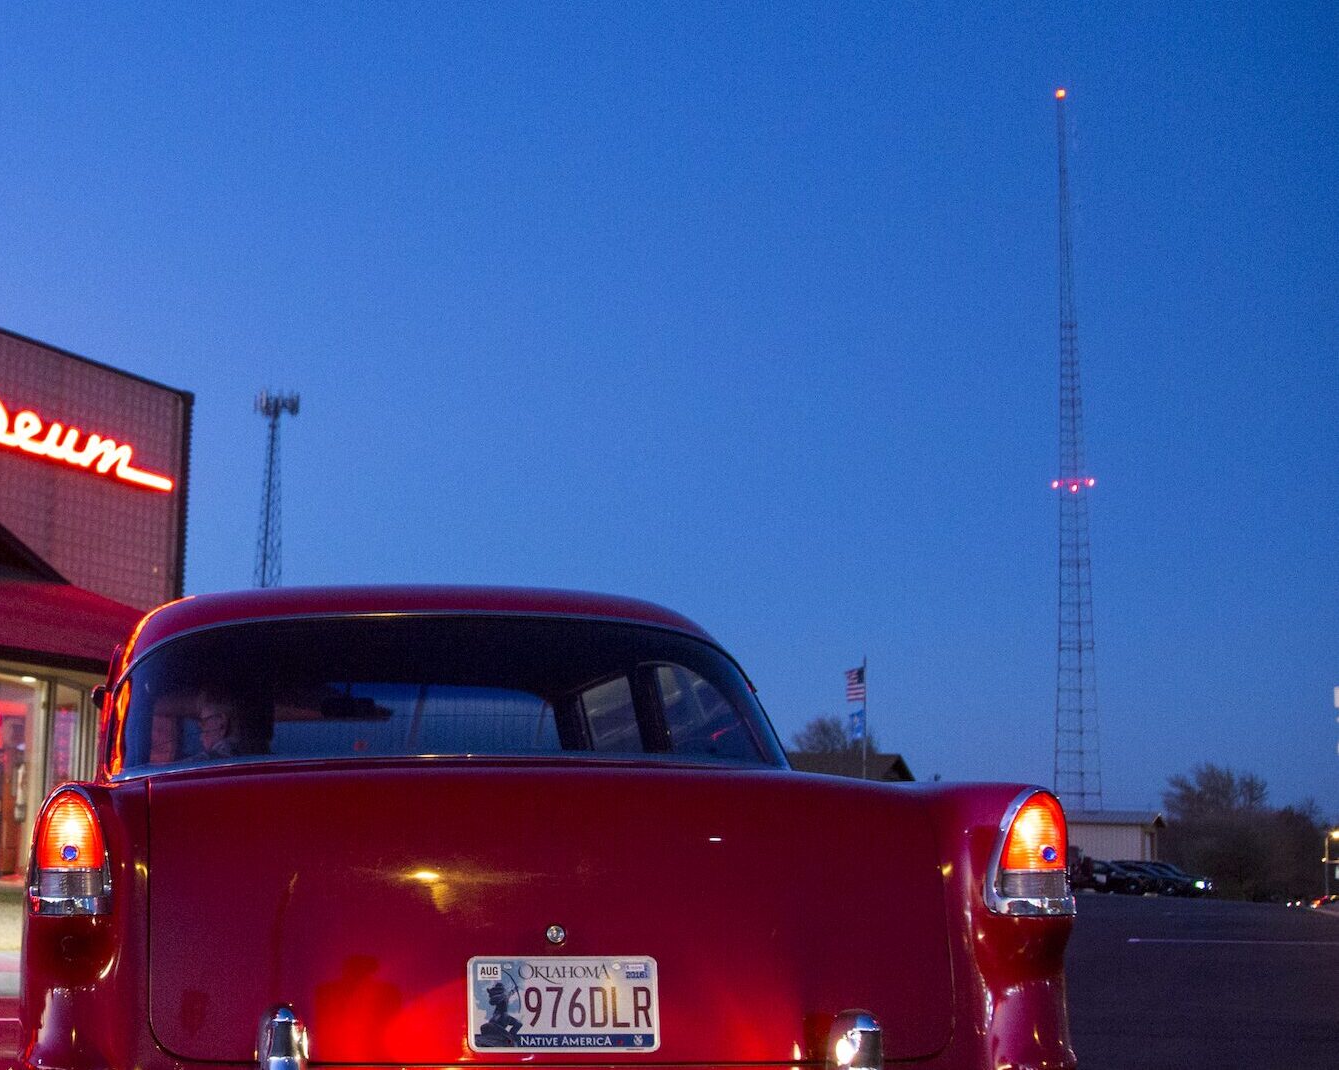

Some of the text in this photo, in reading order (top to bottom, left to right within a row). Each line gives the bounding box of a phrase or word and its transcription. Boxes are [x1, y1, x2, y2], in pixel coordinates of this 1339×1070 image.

[480, 966, 499, 976] AUG
[518, 963, 611, 985] OKLAHOMA
[524, 986, 652, 1028] 976DLR
[520, 1035, 612, 1046] NATIVE AMERICA
